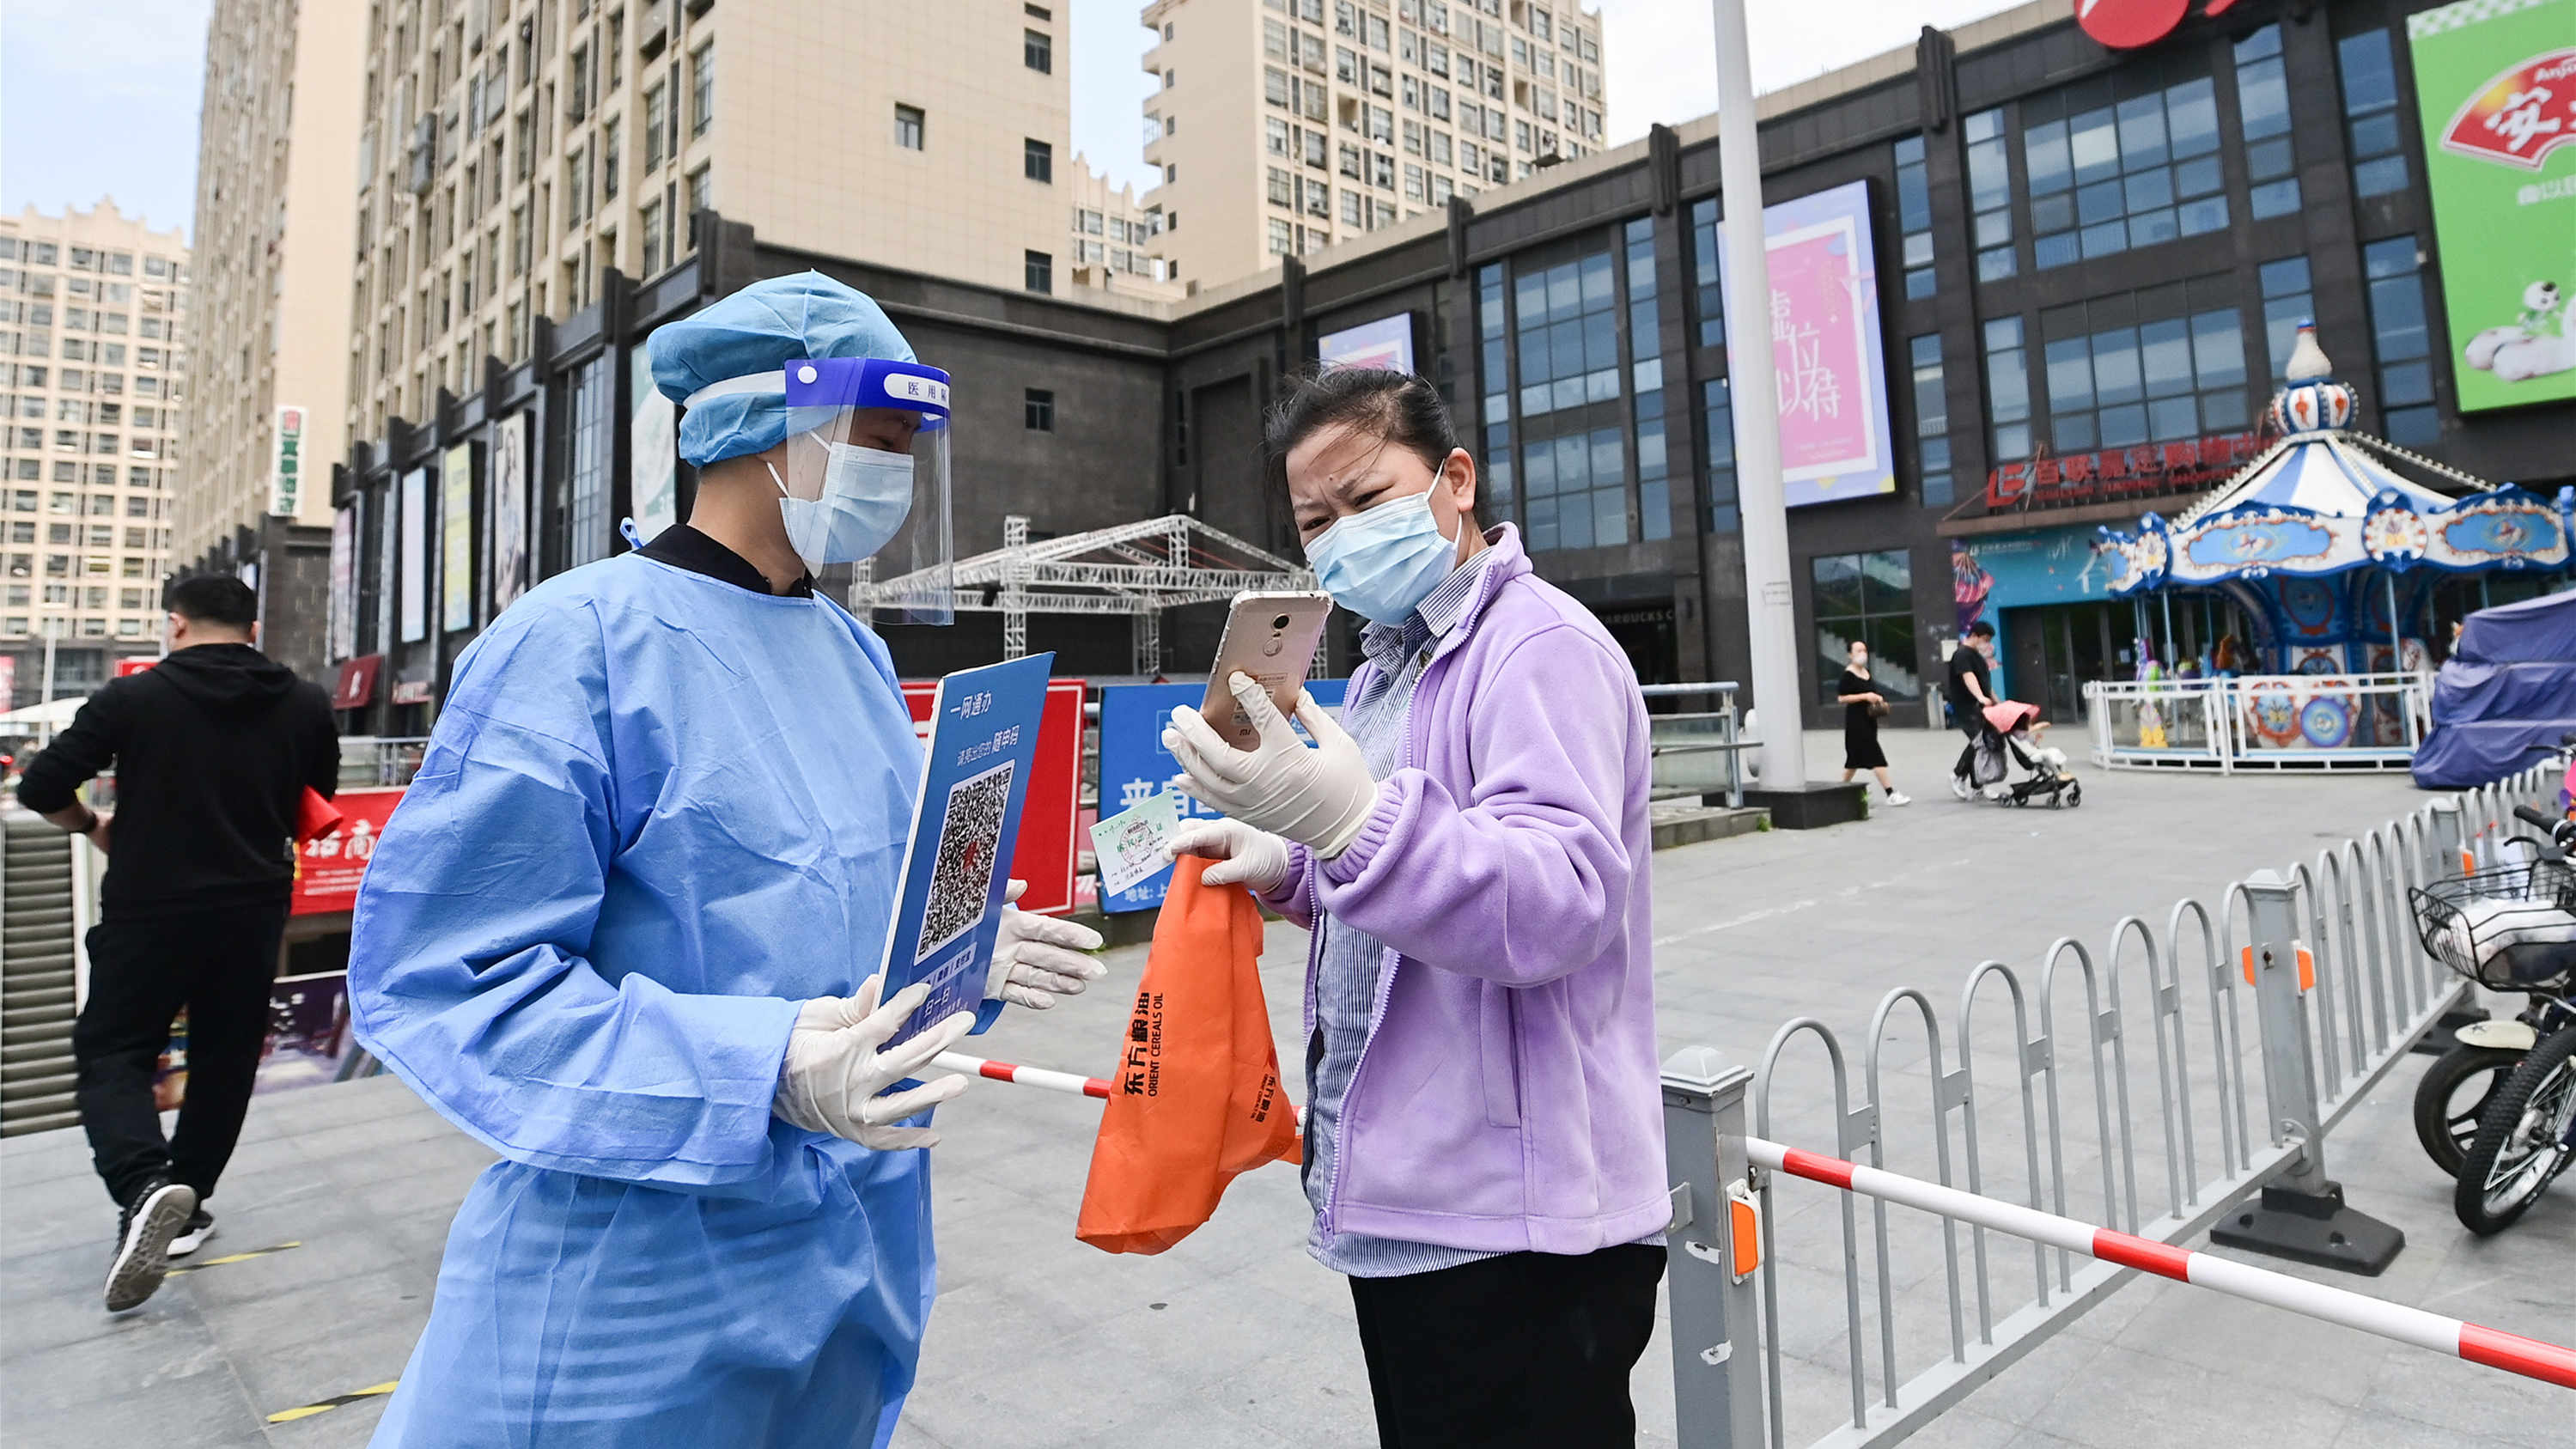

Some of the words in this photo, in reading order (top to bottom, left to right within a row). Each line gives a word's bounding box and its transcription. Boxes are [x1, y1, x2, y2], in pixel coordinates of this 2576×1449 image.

[2483, 86, 2576, 153] 安
[950, 690, 992, 720] 一网通办
[1153, 992, 1163, 1010] OIL
[1124, 992, 1150, 1095] 东方粮油
[1151, 1012, 1162, 1057] CEREALS
[1148, 1060, 1160, 1097] ORIENT
